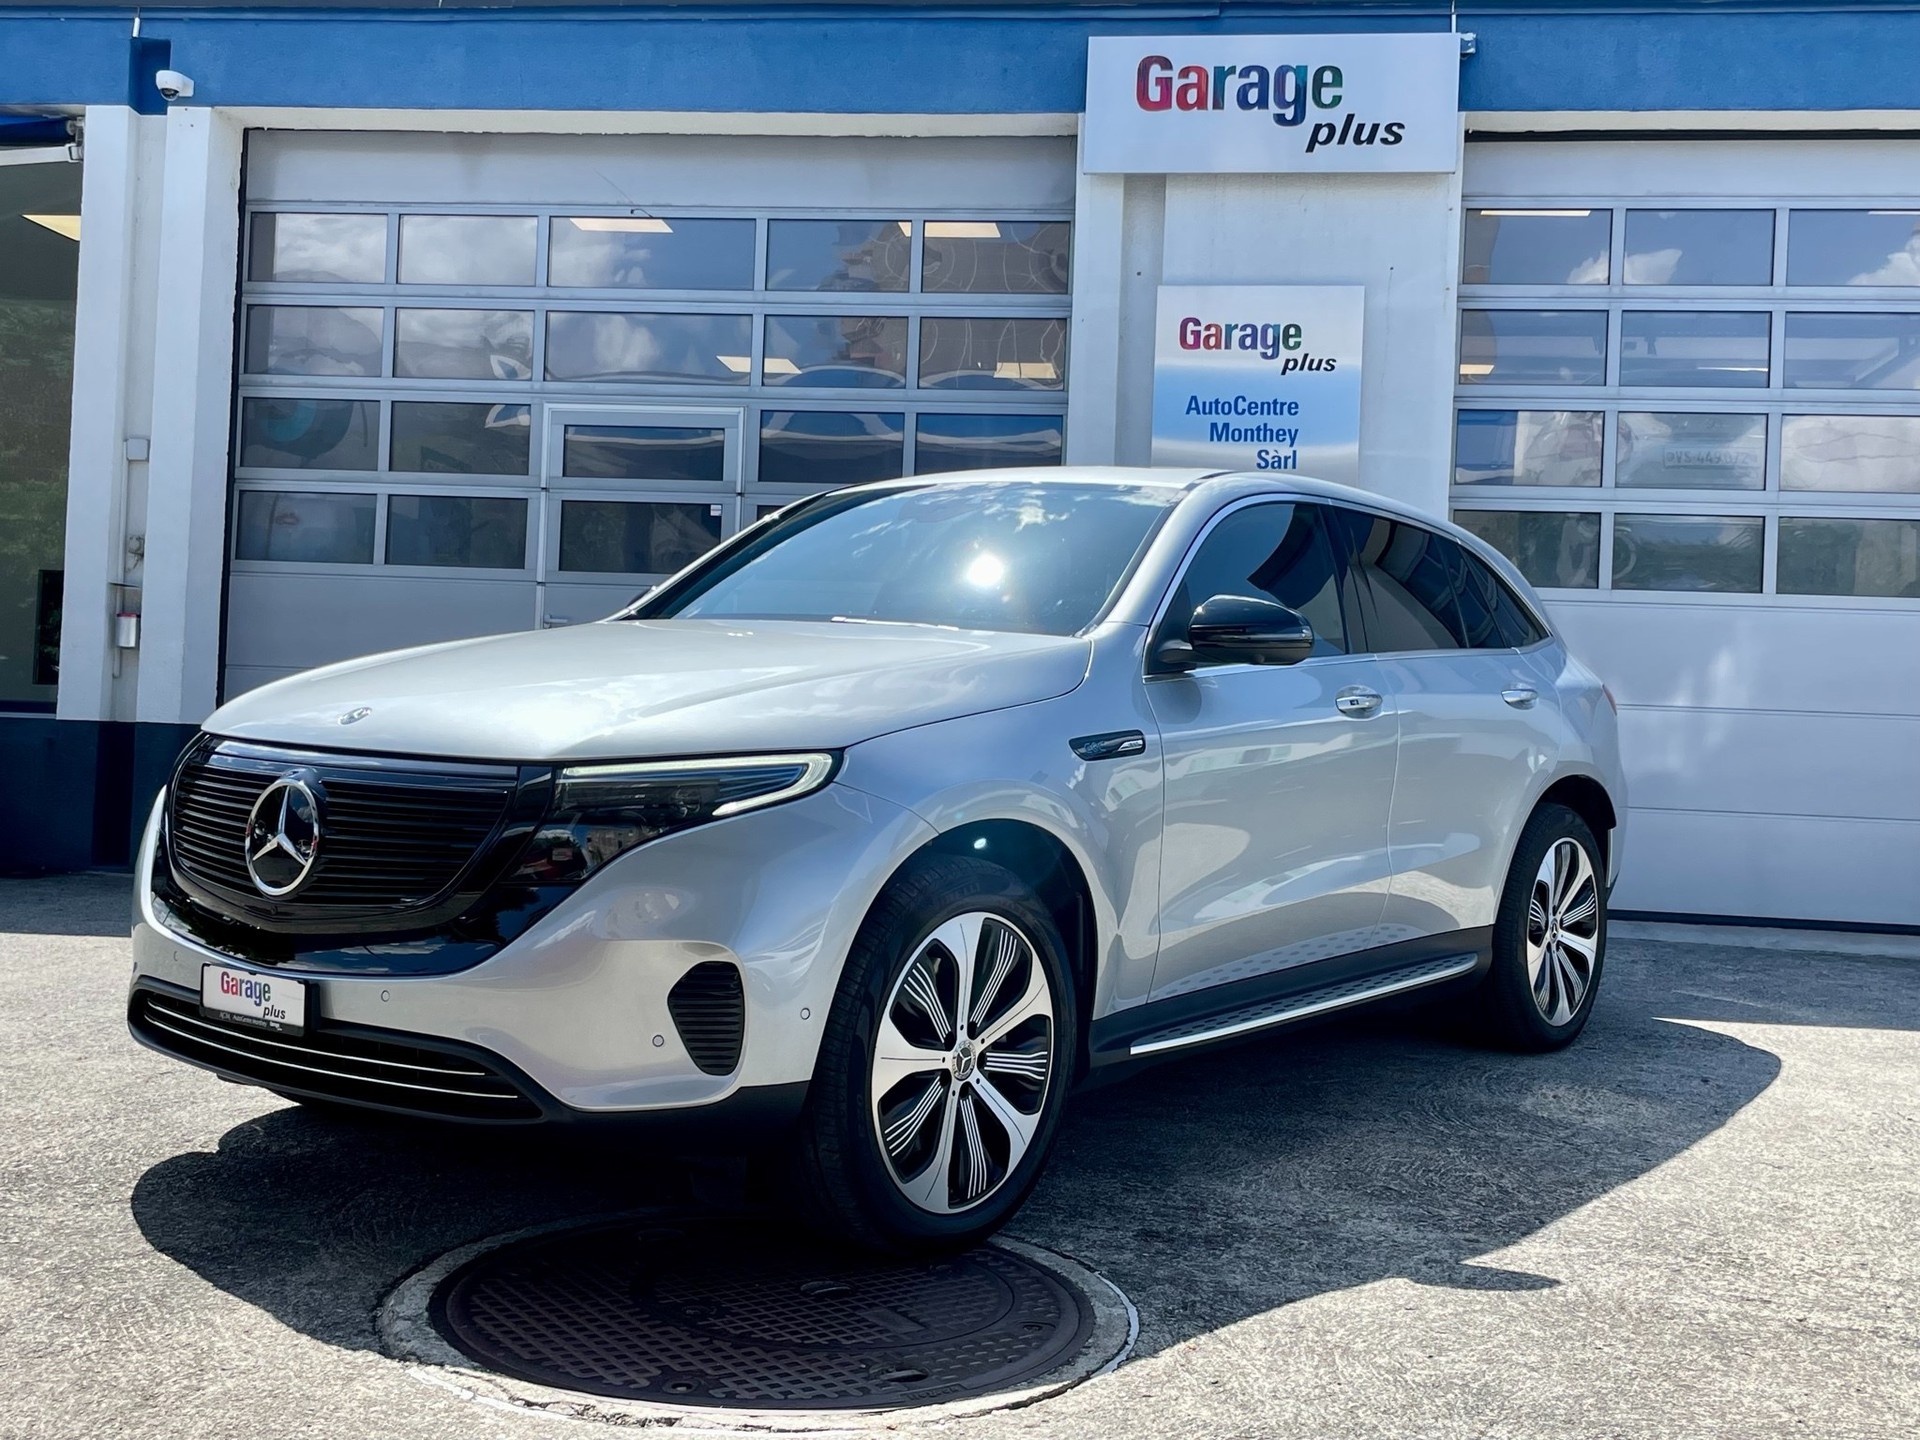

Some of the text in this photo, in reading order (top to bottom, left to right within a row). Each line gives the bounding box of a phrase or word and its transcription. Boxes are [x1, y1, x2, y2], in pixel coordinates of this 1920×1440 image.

[1136, 55, 1343, 126] Garage
[1305, 113, 1405, 152] plus
[1179, 317, 1302, 360] Garage
[1281, 353, 1337, 376] plus
[1185, 395, 1299, 416] AutoCentre
[1209, 422, 1299, 447] Monthey
[1256, 449, 1297, 469] Sàrl
[221, 971, 271, 1006] Garage
[263, 1005, 286, 1019] plus
